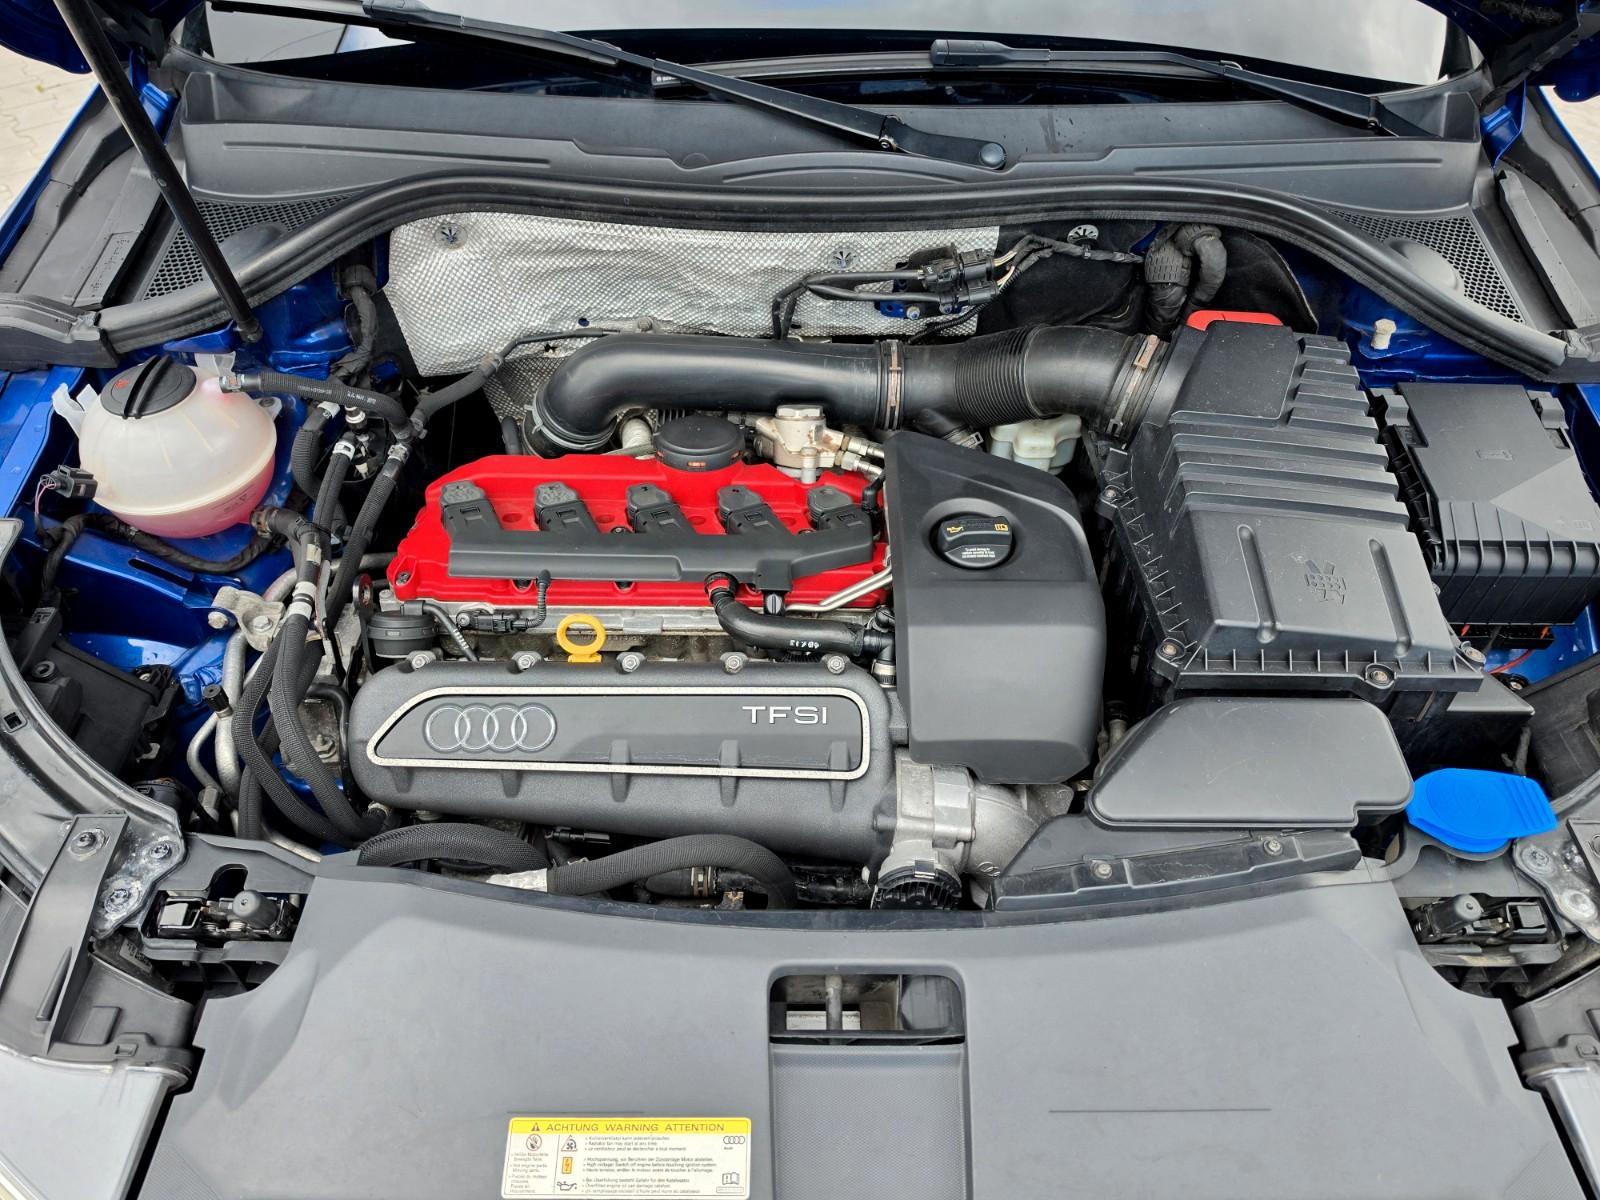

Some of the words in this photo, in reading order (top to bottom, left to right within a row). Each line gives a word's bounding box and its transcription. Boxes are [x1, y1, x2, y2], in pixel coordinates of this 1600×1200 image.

[742, 706, 827, 724] TFSI
[546, 1123, 599, 1132] ACHTUNG
[605, 1123, 659, 1132] WARNING
[664, 1123, 725, 1132] ATTENTION
